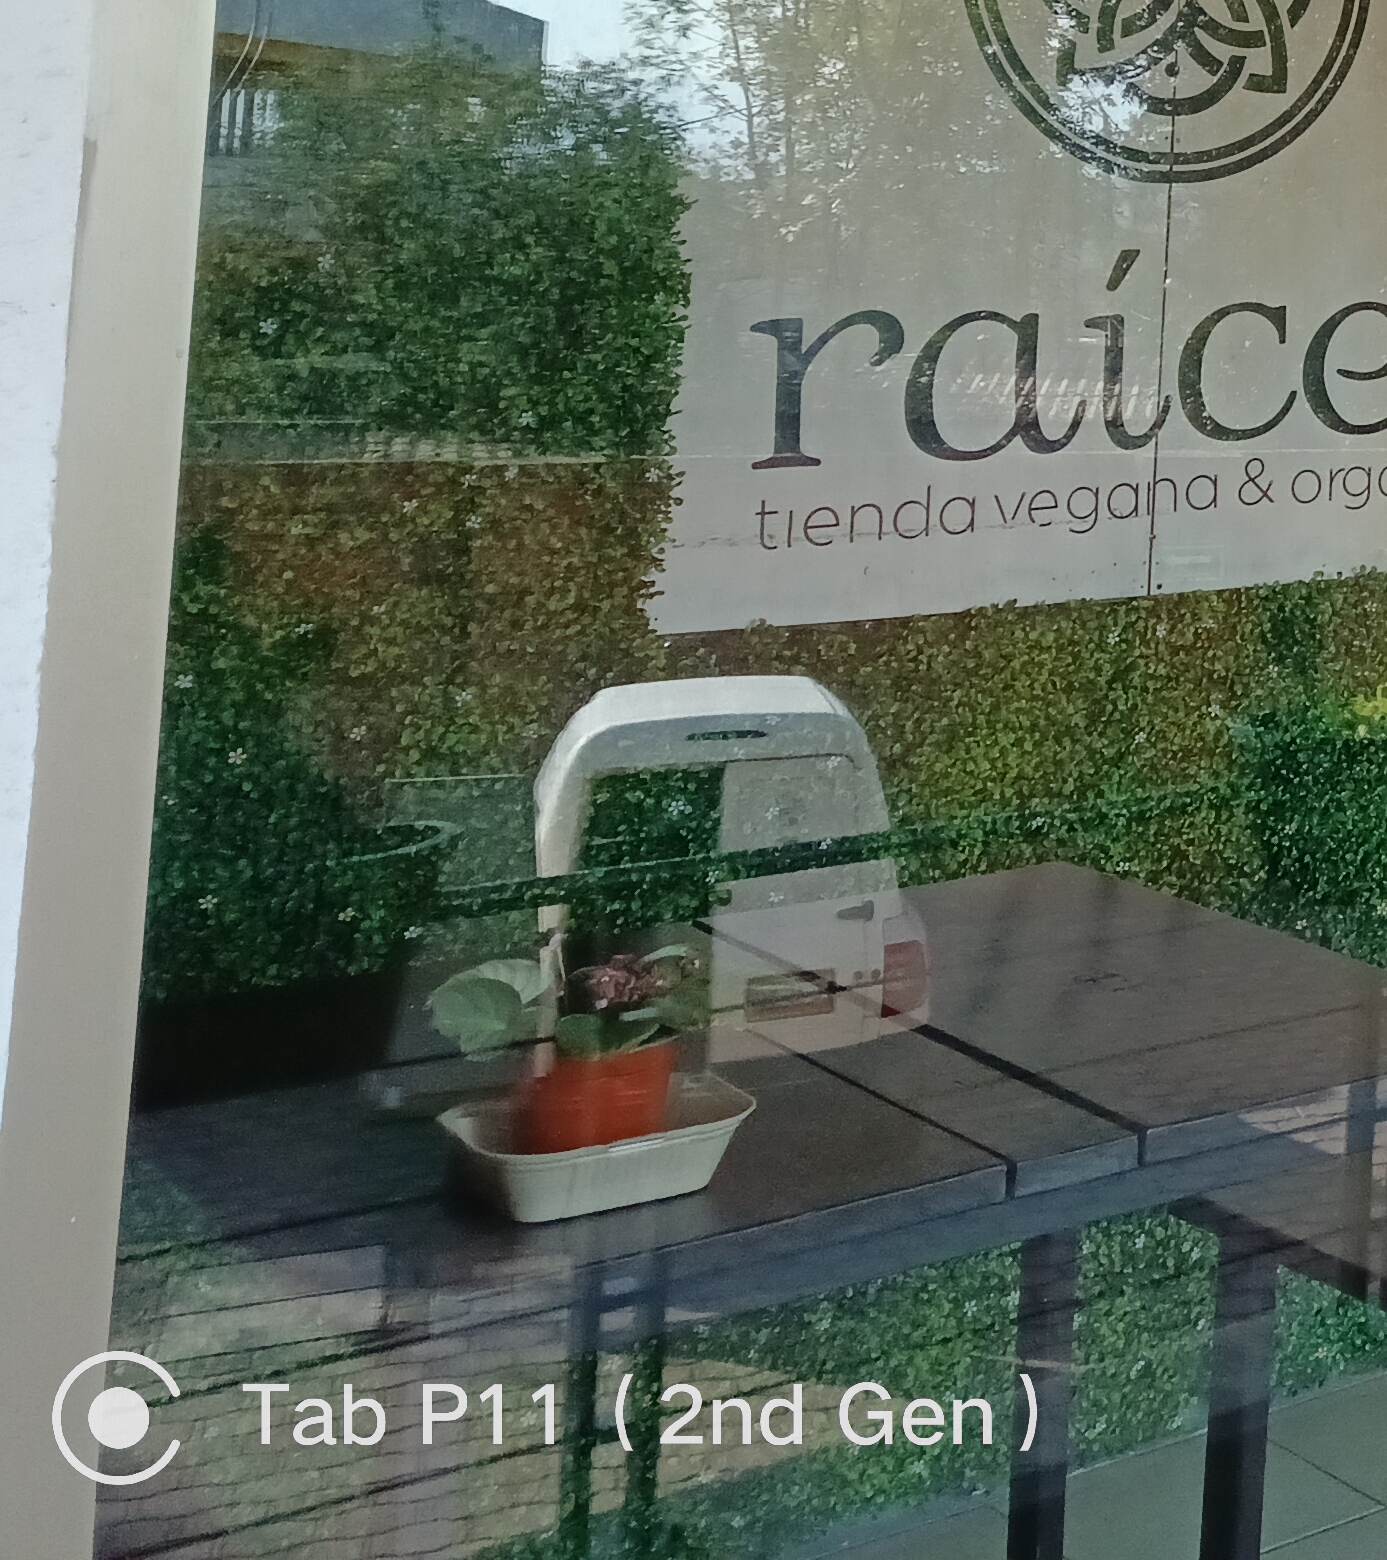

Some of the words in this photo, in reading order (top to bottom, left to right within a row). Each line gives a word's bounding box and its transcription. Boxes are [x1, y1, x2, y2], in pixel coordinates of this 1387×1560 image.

[754, 484, 977, 550] tienda
[994, 473, 1219, 535] vegana
[1238, 457, 1275, 506] &
